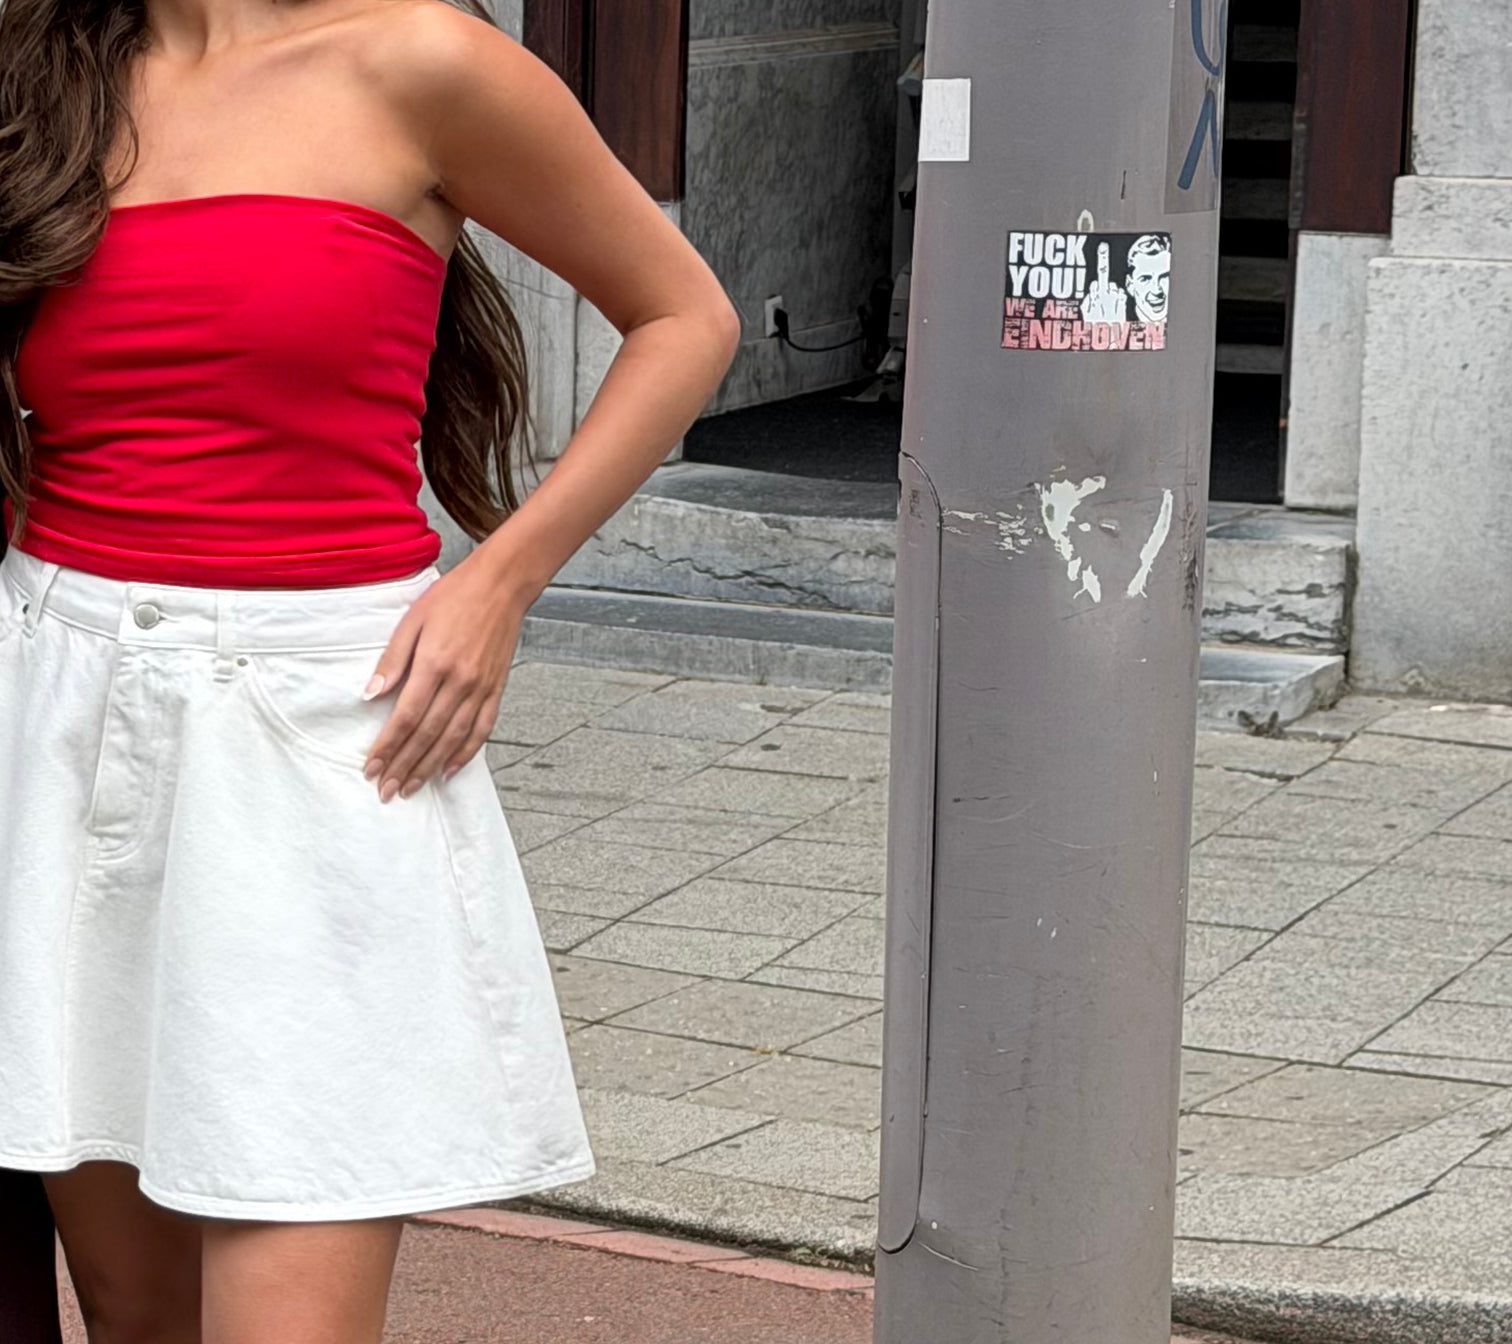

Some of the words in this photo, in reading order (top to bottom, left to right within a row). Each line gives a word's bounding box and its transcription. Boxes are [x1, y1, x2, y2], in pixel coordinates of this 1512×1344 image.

[1008, 232, 1088, 266] FUCK
[1008, 264, 1087, 299] YOU!
[1005, 297, 1035, 317] WE
[1042, 299, 1080, 319] ARE
[1000, 317, 1167, 351] EINDHOVEN
